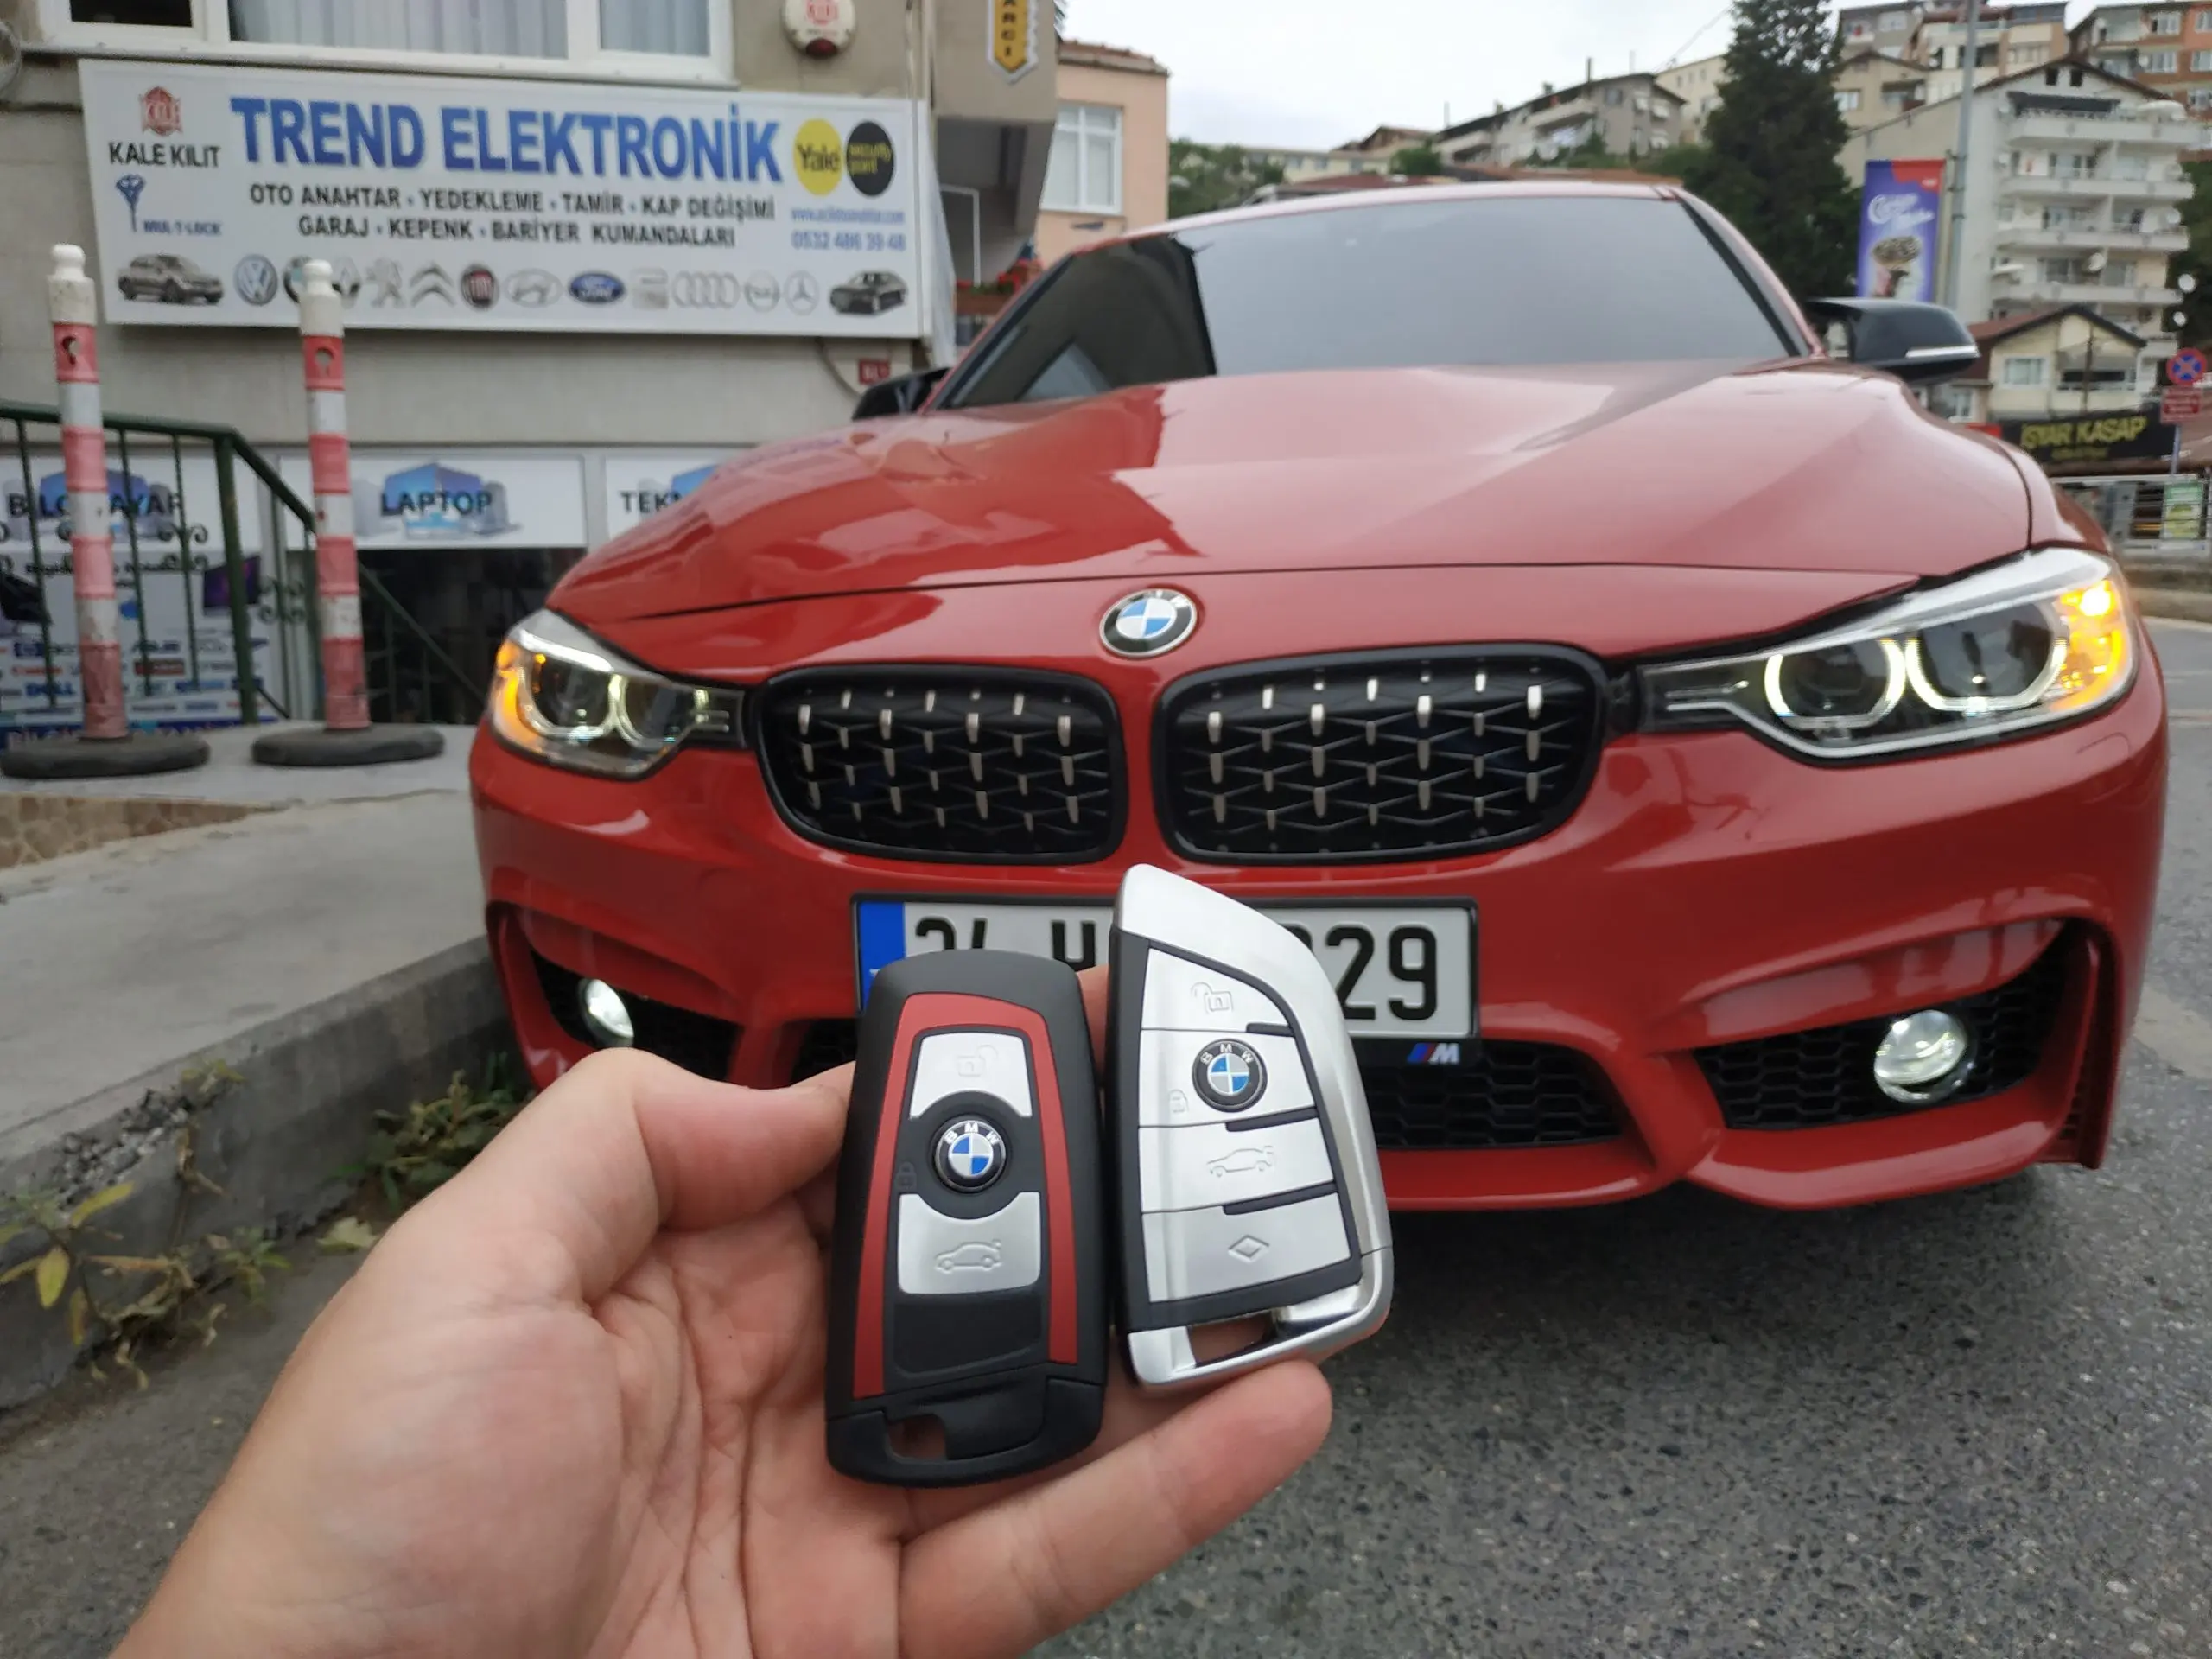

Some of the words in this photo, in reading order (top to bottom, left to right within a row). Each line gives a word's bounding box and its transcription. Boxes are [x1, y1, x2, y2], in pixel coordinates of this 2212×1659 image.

[109, 142, 166, 165] KALE
[230, 97, 425, 168] TREND
[441, 103, 784, 183] ELEKTRONİK
[798, 143, 840, 172] Yale
[250, 184, 294, 206] OTO
[301, 185, 400, 209] ANAHTAR
[419, 188, 543, 213] YEDEKLEME
[563, 188, 624, 215] TAMİR
[641, 195, 681, 216] KAP
[298, 215, 369, 238] GARAJ
[388, 218, 474, 241] KEPENK
[492, 216, 580, 244] BARİYER
[591, 222, 735, 248] KUMANDALARI
[381, 491, 493, 517] LAPTOP
[1199, 1042, 1255, 1065] BMW
[943, 1122, 1000, 1146] BMW
